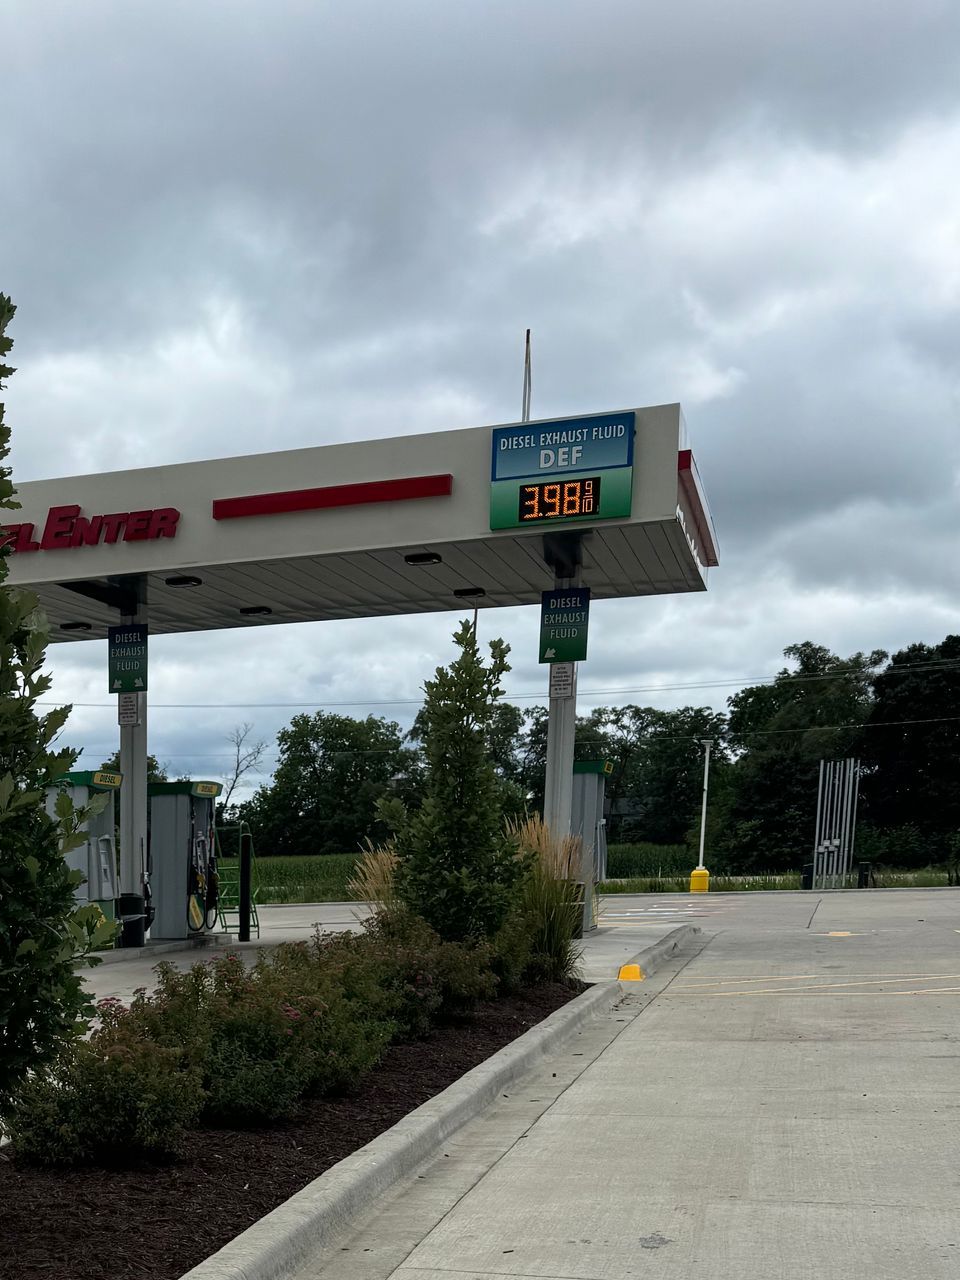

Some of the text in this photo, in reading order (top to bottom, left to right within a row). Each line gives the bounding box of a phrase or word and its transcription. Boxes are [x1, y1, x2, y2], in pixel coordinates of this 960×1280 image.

[500, 424, 625, 450] DIESEL EXHAUST FLUID
[539, 445, 583, 469] DEF
[41, 504, 181, 550] ENTER
[550, 597, 582, 609] DIESEL
[544, 612, 586, 624] EXHAUST
[115, 632, 142, 643] DIESEL
[550, 628, 578, 639] FLUID
[111, 646, 145, 657] EXHAUST
[117, 661, 140, 671] FLUID
[99, 774, 116, 784] DIESEL
